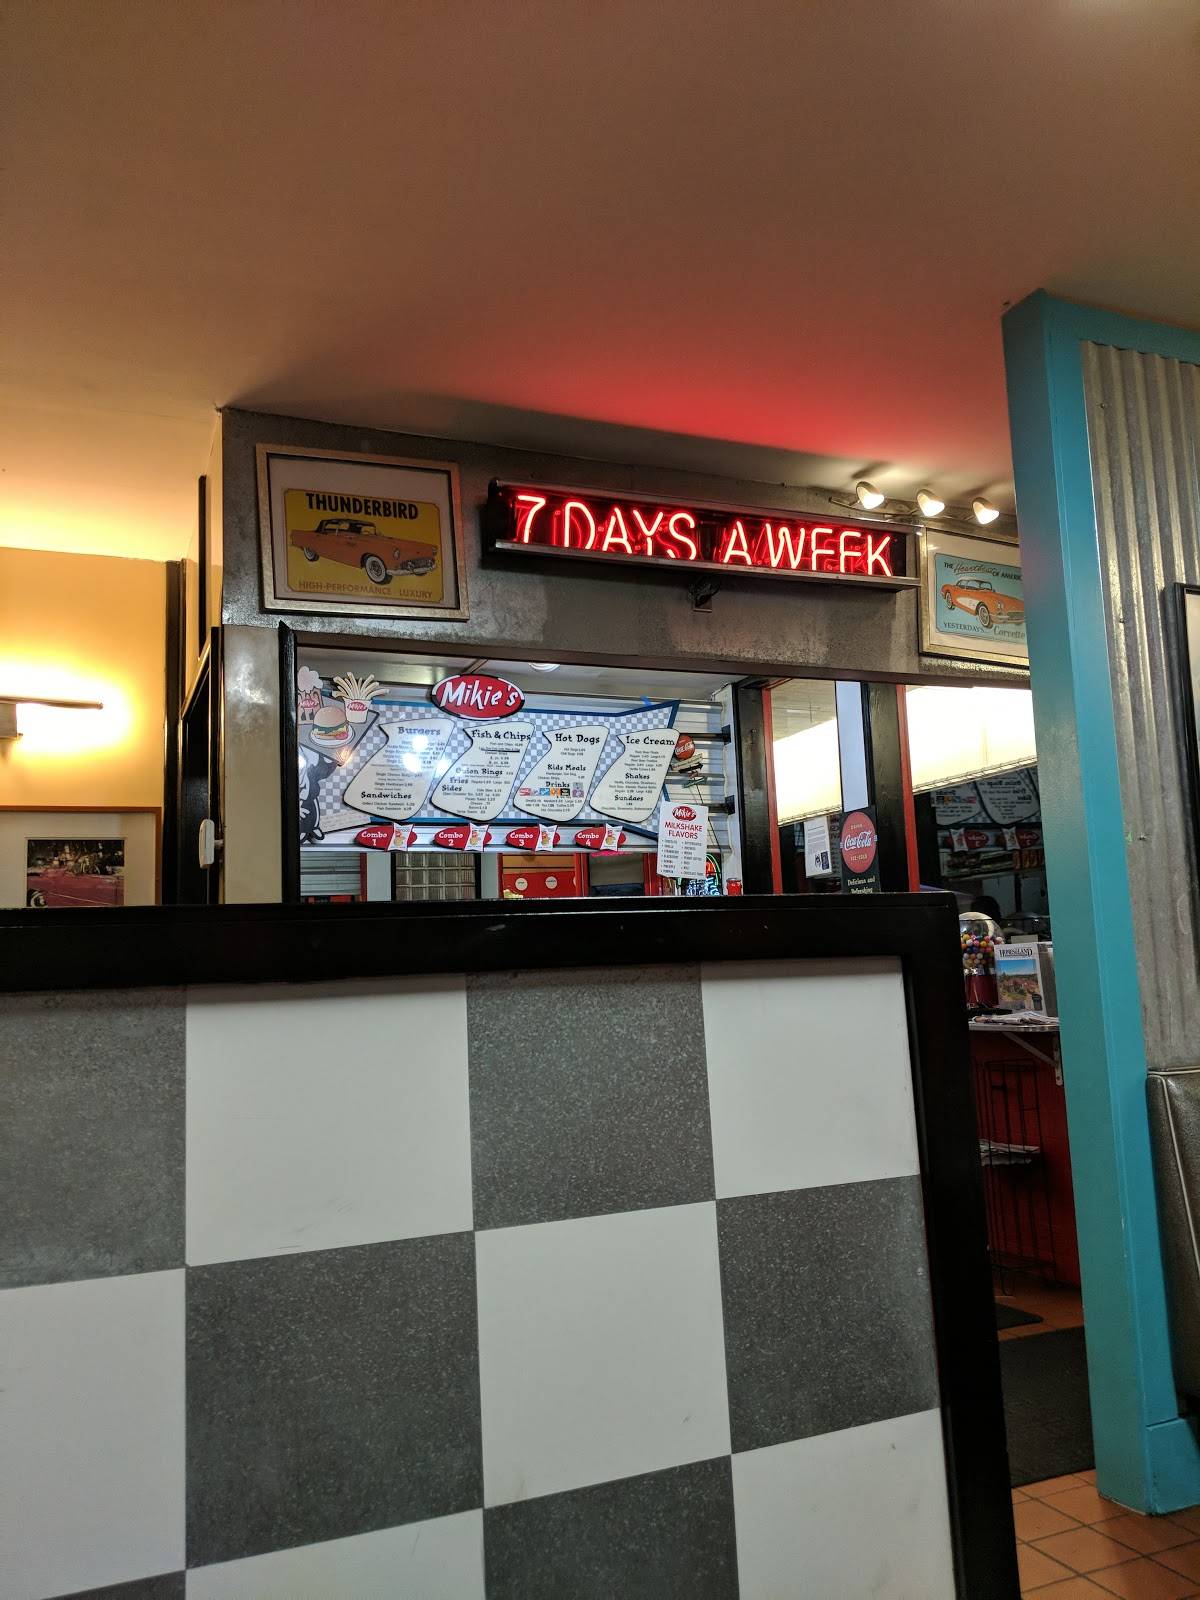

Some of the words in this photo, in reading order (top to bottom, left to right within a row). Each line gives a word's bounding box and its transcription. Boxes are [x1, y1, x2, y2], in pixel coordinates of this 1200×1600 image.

[305, 492, 419, 520] THUNDERBIRD
[517, 495, 546, 543] 7
[564, 502, 697, 560] DAYS
[723, 520, 753, 566] A
[298, 580, 392, 596] HIGH-PERFORMANCE
[399, 587, 433, 599] LUXURY
[440, 679, 519, 710] Mikie's
[397, 726, 441, 736] Burgers
[471, 729, 492, 739] Fish
[494, 731, 501, 739] &
[503, 731, 532, 742] Chips
[555, 732, 572, 742] Hot
[576, 734, 600, 745] Dogs
[626, 735, 640, 745] Ice
[643, 736, 675, 746] Cream
[547, 763, 563, 771] Kids
[481, 768, 503, 777] Rings
[625, 772, 650, 780] Shakes
[449, 776, 469, 784] Fries
[441, 784, 463, 792] Sides
[360, 791, 412, 800] Sandwiches
[614, 794, 644, 802] Sundaes
[664, 821, 703, 833] MILKSHAKE
[438, 831, 464, 839] Combo
[509, 831, 534, 839] Combo
[577, 831, 600, 839] Combo
[668, 829, 699, 840] FLAVORS
[371, 838, 377, 846] 1
[448, 838, 454, 846] 2
[519, 839, 525, 847] 3
[585, 839, 591, 847] 4
